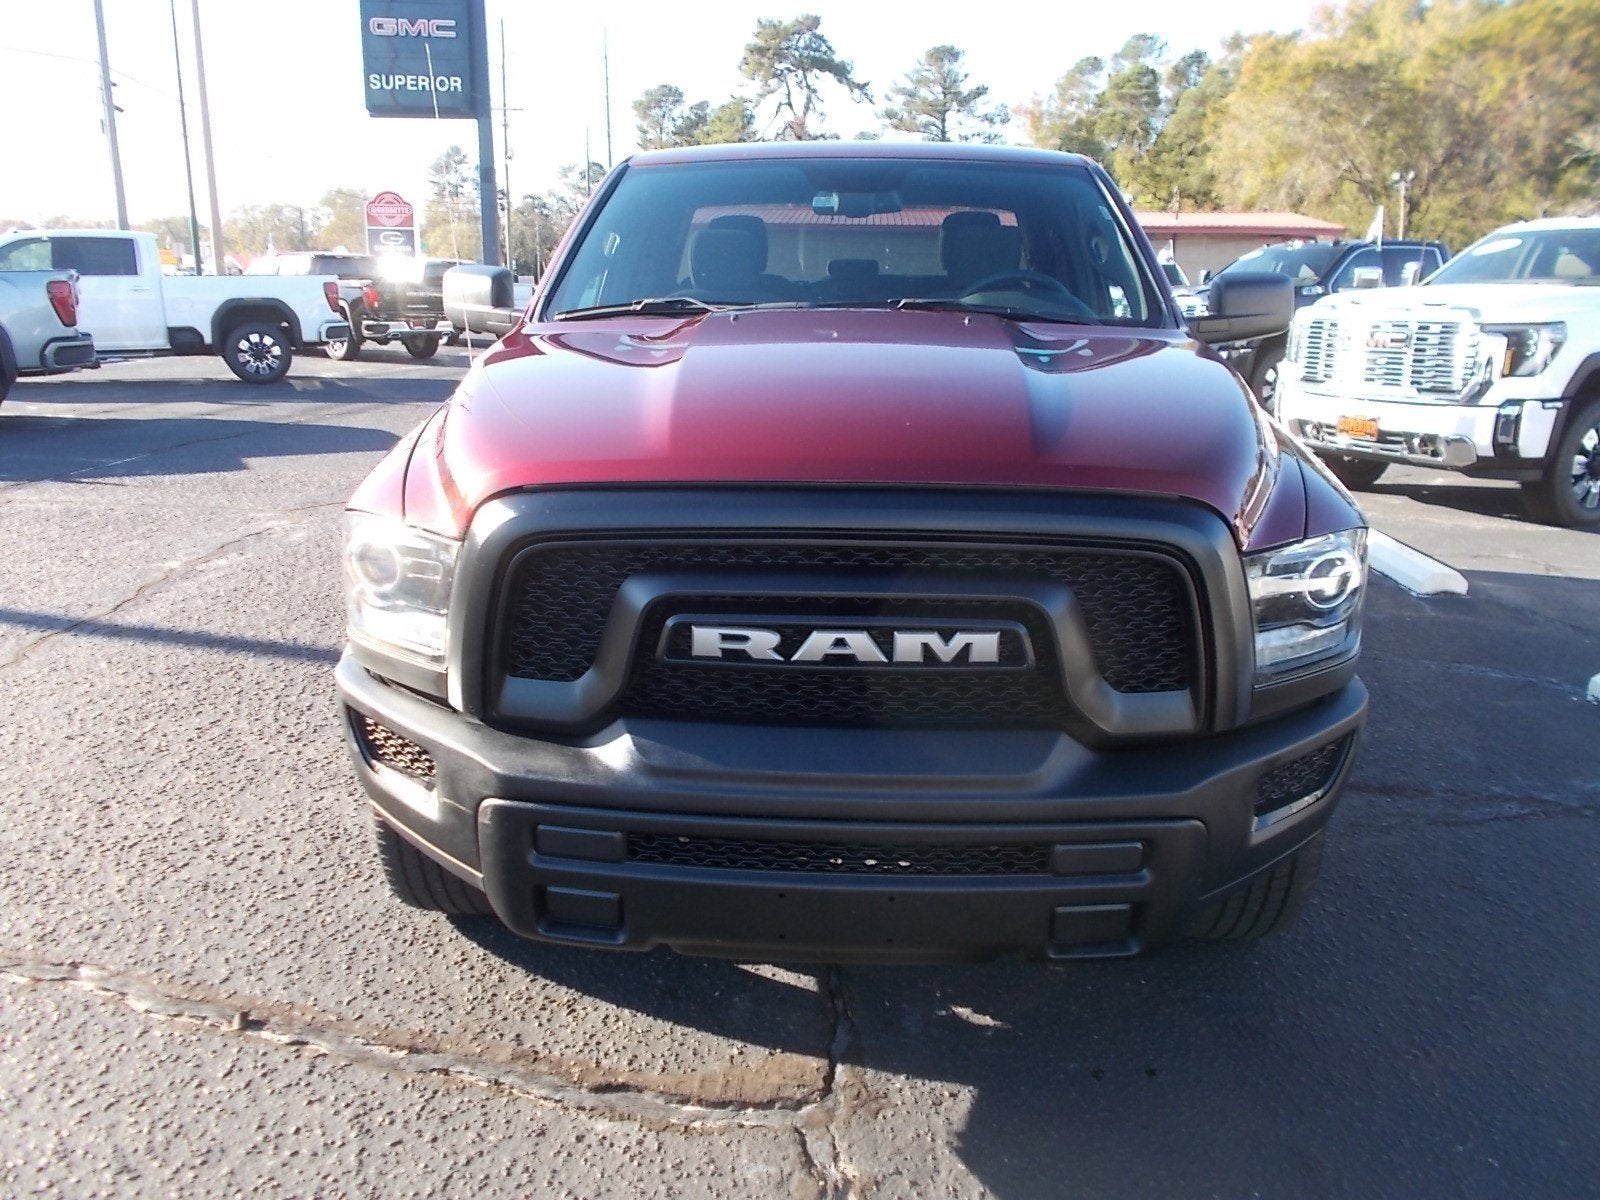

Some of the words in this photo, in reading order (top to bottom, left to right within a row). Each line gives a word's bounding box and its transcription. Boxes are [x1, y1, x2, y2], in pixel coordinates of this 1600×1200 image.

[369, 17, 457, 38] GMC
[368, 73, 462, 92] SUPERIOR
[691, 625, 1000, 663] RAM
